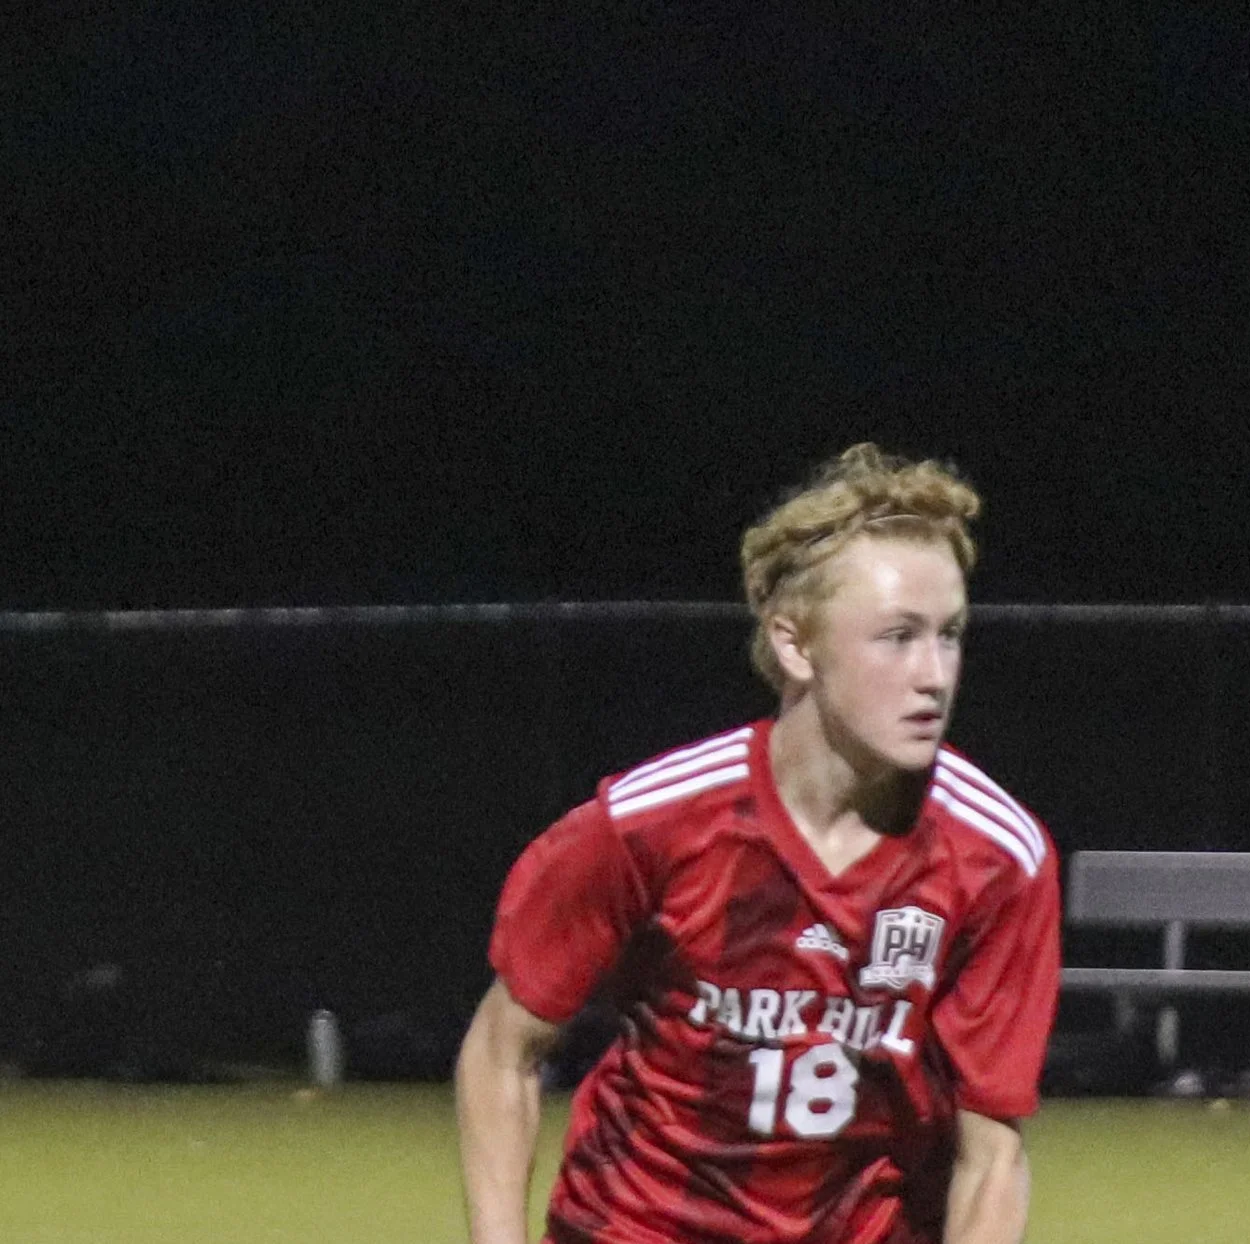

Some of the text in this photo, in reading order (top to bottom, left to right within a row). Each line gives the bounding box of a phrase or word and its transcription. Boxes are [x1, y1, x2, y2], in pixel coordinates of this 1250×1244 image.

[882, 925, 932, 966] PH
[689, 981, 818, 1039] PARK
[748, 1043, 859, 1136] 18
